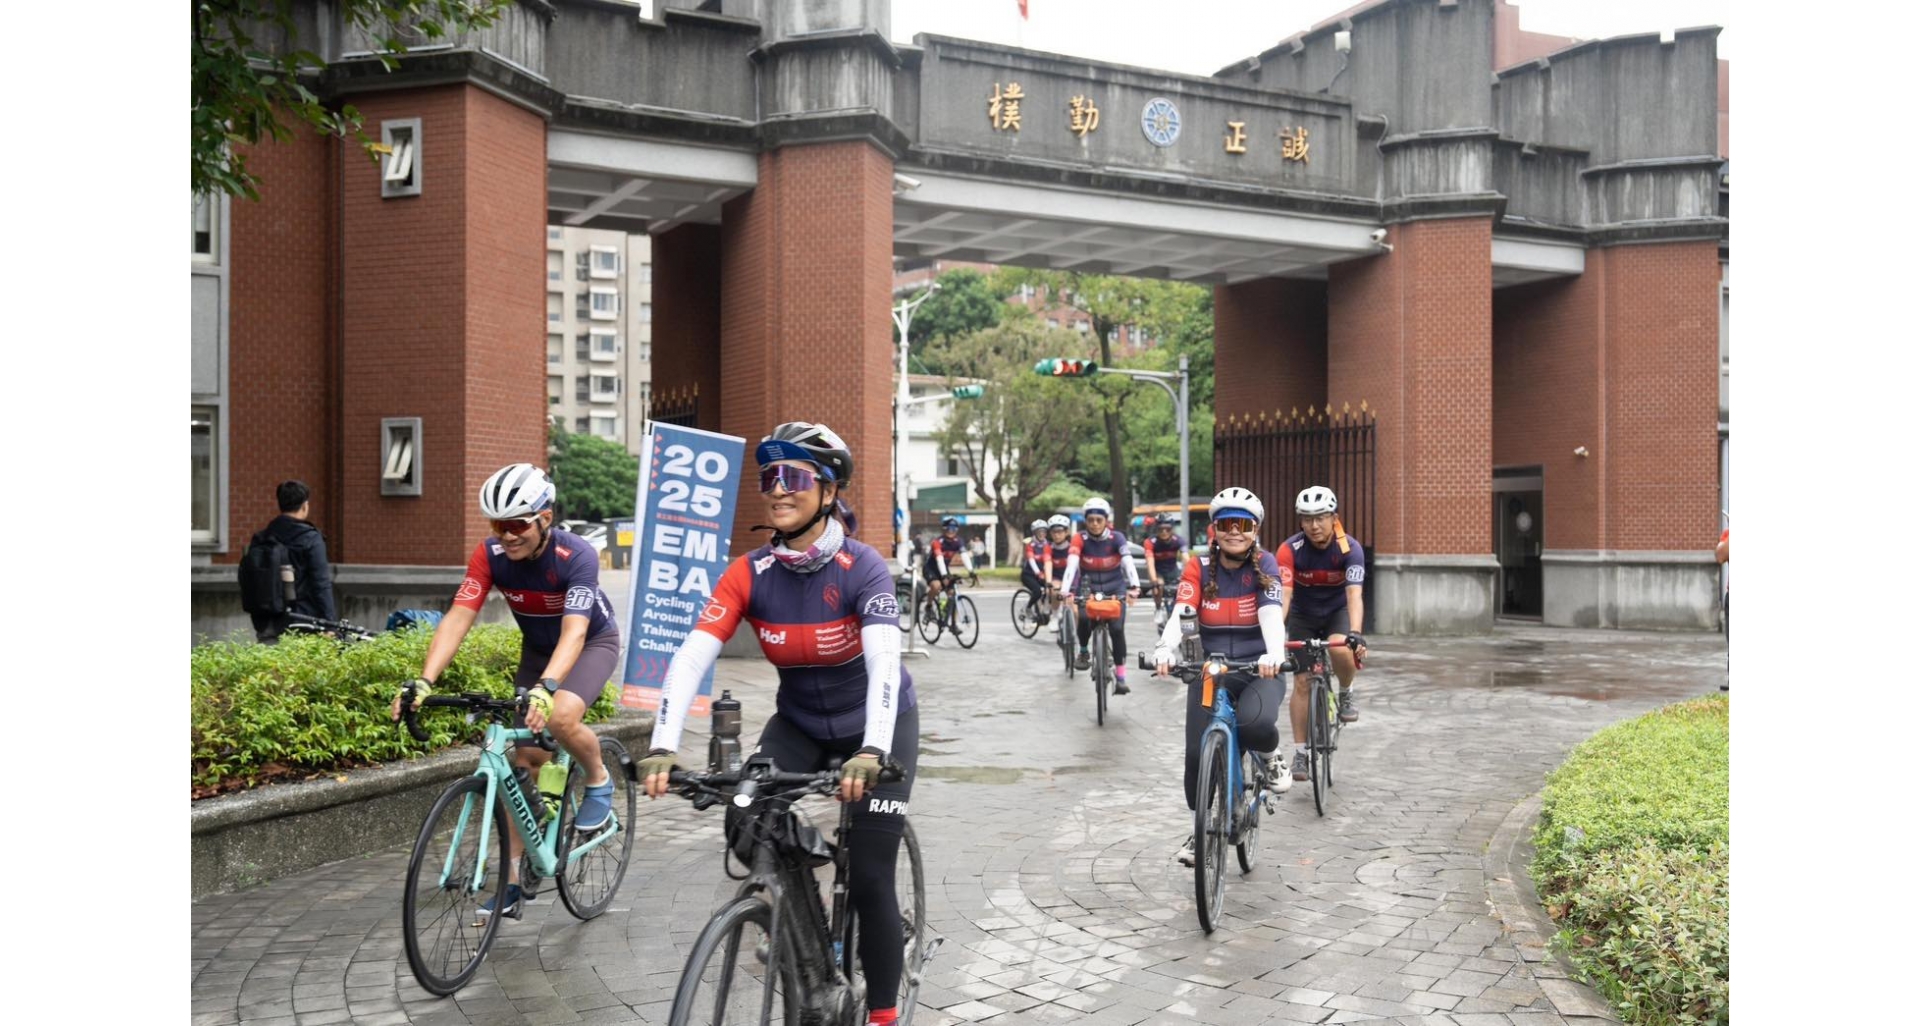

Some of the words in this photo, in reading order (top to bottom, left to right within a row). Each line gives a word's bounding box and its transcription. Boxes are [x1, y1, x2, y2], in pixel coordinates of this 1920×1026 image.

[662, 444, 729, 483] 20
[658, 480, 723, 517] 25
[653, 524, 718, 563] EM
[648, 559, 712, 597] BA
[642, 608, 693, 625] Around
[645, 593, 695, 613] Cycling
[1202, 600, 1220, 610] Ho!
[641, 623, 689, 640] Taiwan
[759, 627, 787, 645] Ho!
[504, 774, 542, 849] Bianchi
